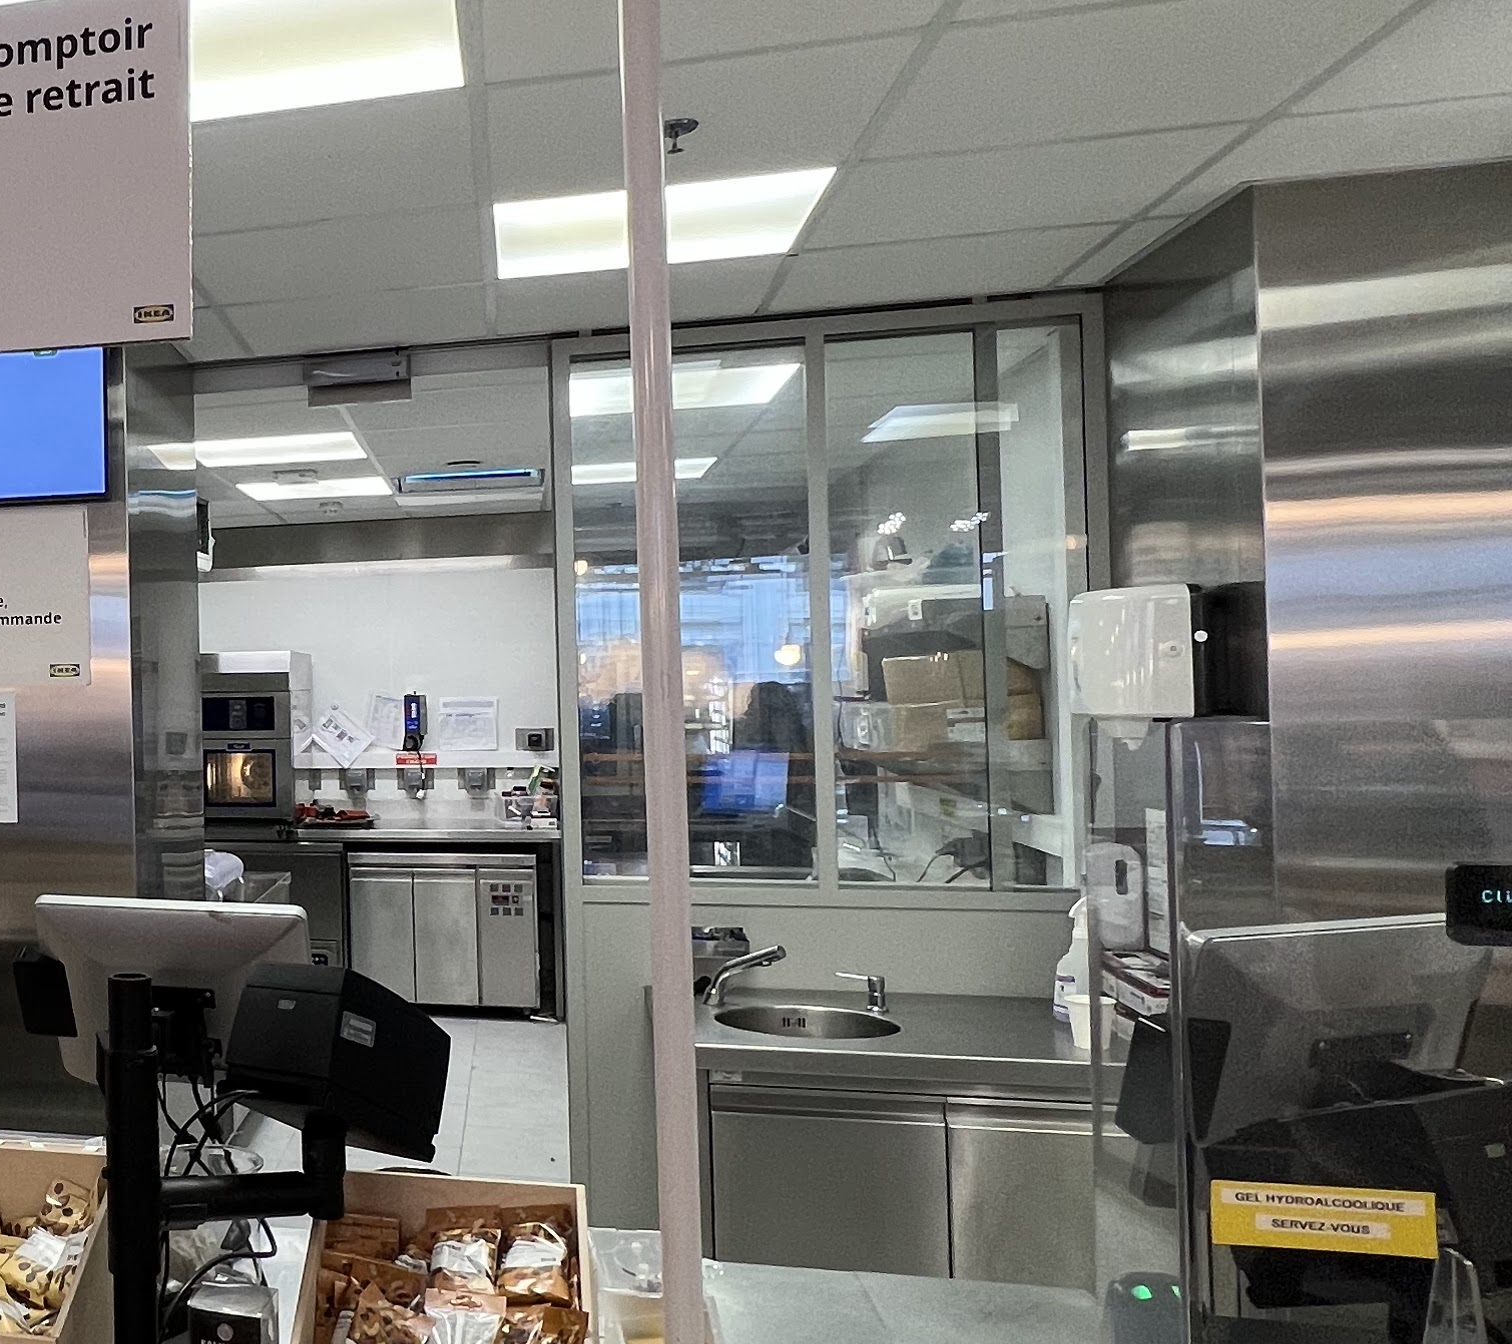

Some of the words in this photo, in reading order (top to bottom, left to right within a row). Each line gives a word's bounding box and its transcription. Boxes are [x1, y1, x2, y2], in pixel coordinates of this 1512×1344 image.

[26, 68, 156, 114] retrait
[1234, 1191, 1262, 1203] GEL
[1265, 1193, 1405, 1213] HYDROALCOOLIQUE
[1271, 1218, 1371, 1235] SERVEZ-VOUS
